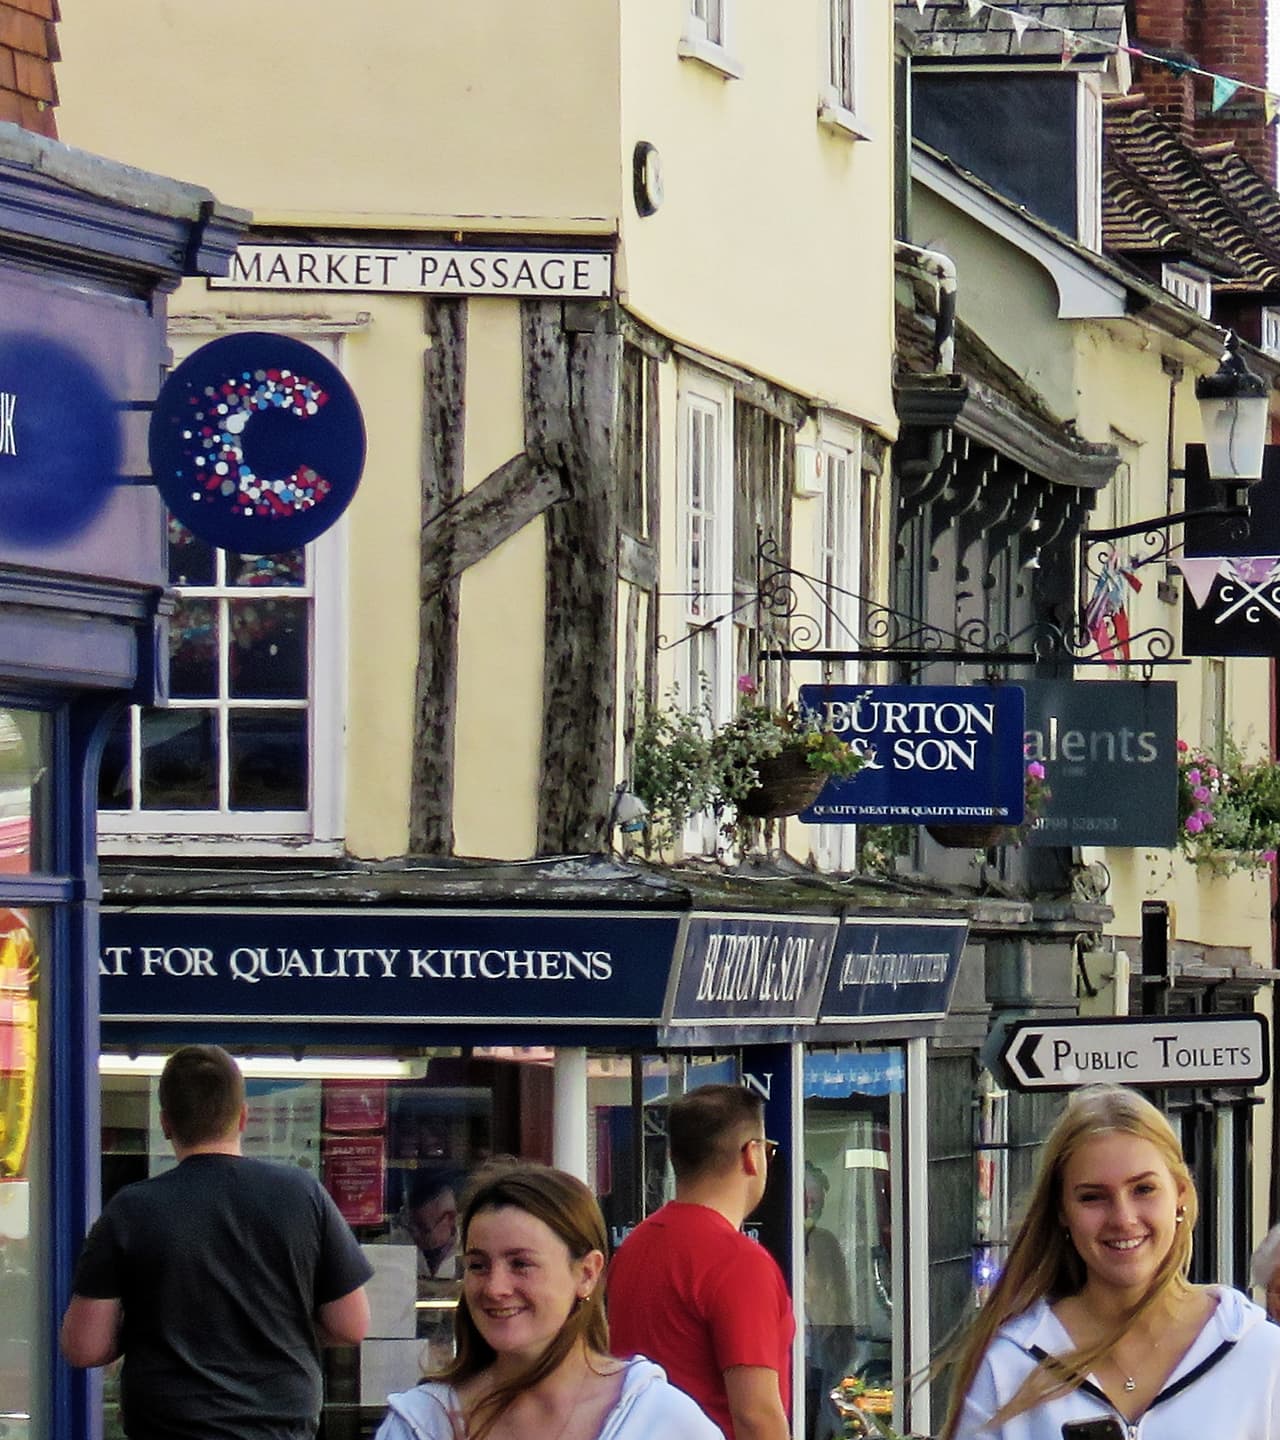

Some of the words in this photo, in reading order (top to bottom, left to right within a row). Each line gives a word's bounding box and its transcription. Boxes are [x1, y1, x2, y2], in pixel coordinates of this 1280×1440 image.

[232, 251, 399, 286] MARKET
[419, 256, 592, 290] PASSAGE
[823, 701, 995, 736] BURTON
[893, 738, 977, 772] SON
[1025, 715, 1158, 763] alents
[813, 805, 857, 816] QUALITY
[858, 806, 889, 816] MEAT
[890, 806, 910, 816] FOR
[911, 806, 954, 817] QUALITY
[957, 806, 1009, 817] KITCHENS
[140, 947, 218, 977] FOR
[229, 947, 399, 984] QUALITY
[409, 949, 613, 981] KITCHENS
[696, 934, 770, 1001] BURTON
[779, 935, 814, 1001] SON
